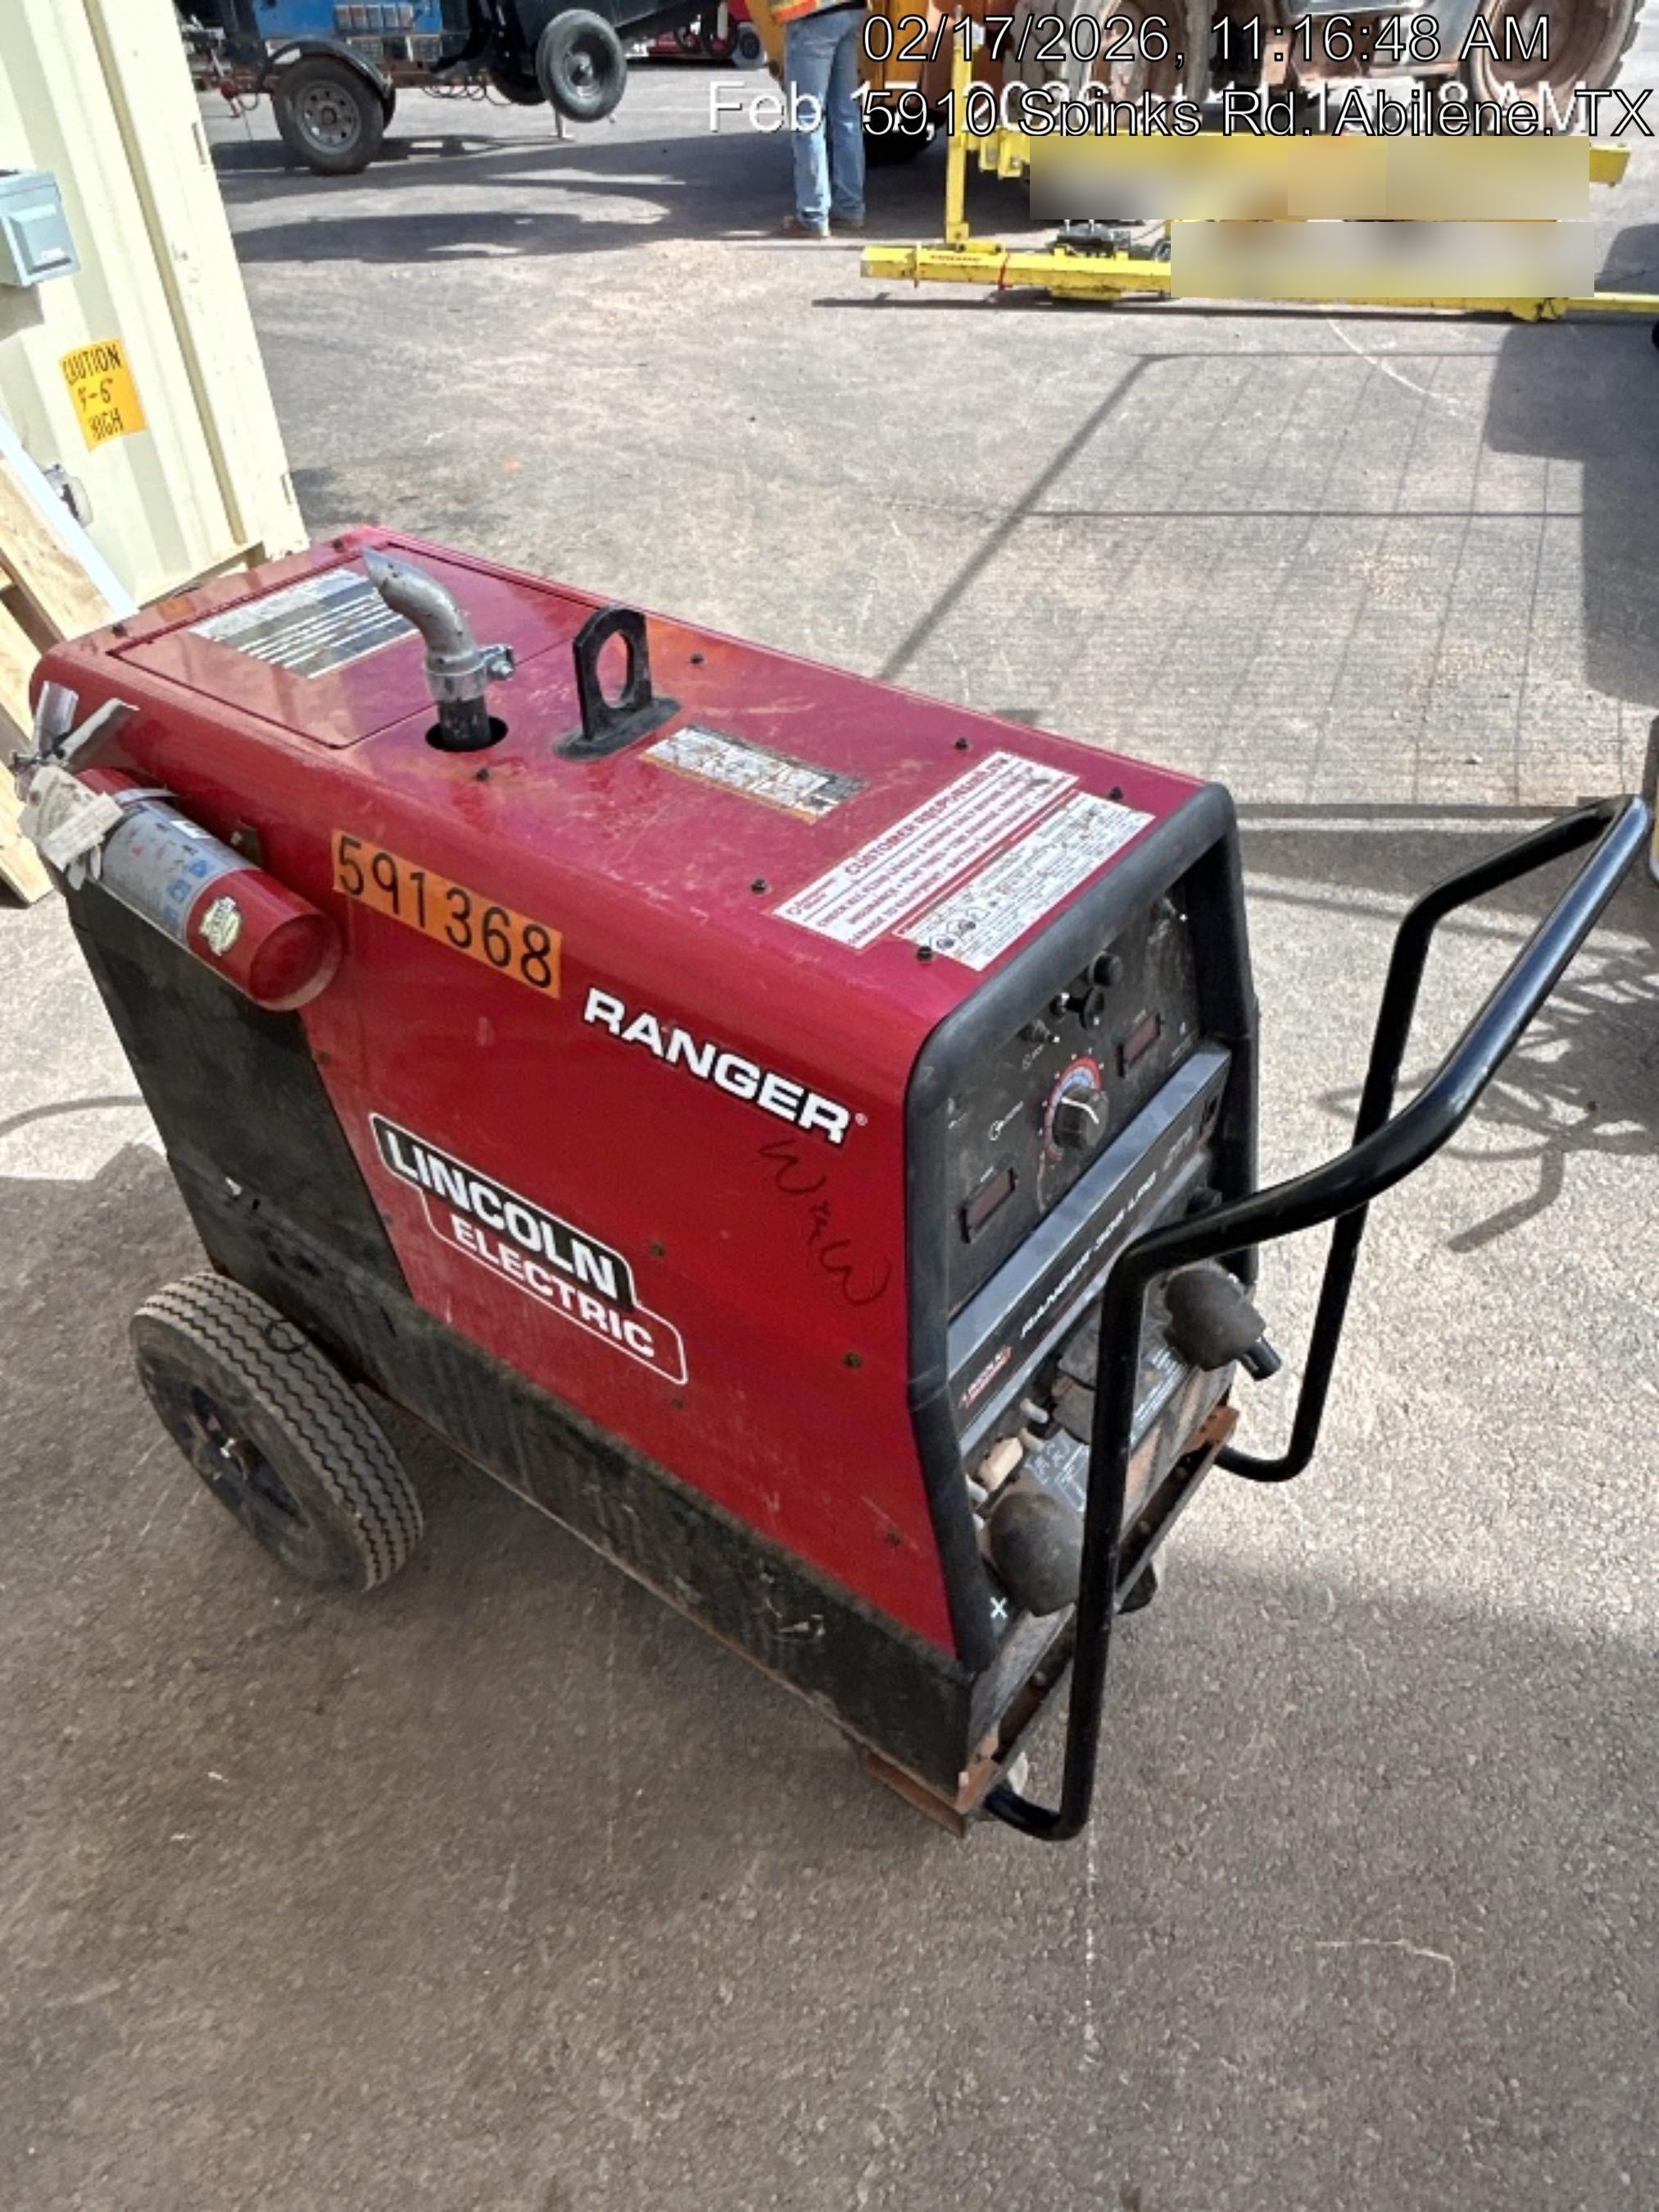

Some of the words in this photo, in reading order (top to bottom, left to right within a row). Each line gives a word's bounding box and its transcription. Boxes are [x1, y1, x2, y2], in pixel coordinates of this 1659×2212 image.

[336, 834, 554, 993] 591368
[383, 1129, 619, 1301] LINCOLN
[451, 1213, 656, 1360] ELECTRIC
